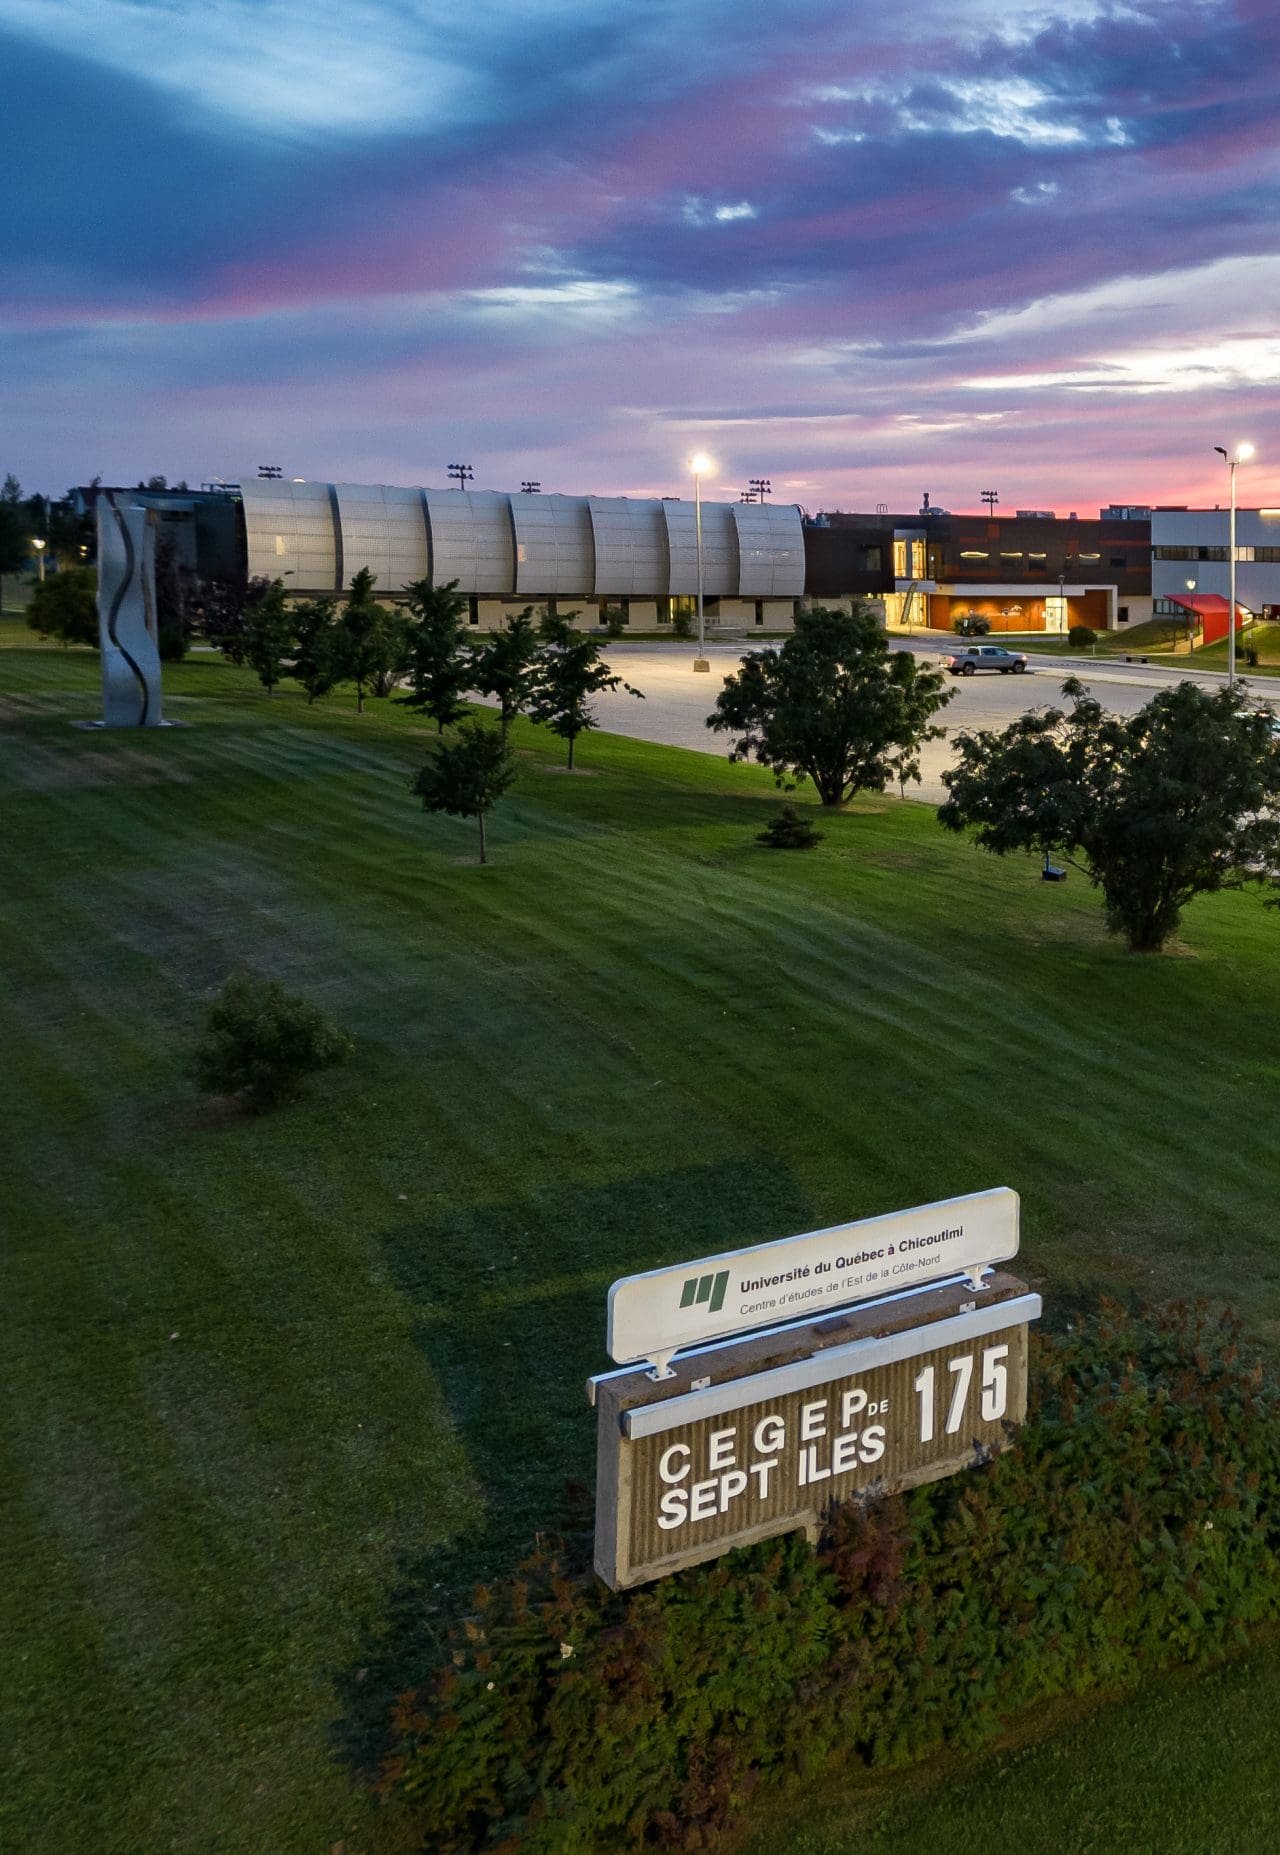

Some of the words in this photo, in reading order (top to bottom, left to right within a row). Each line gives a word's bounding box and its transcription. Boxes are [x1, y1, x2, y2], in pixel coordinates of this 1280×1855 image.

[740, 1264, 810, 1293] Université
[814, 1260, 831, 1275] du
[835, 1248, 884, 1270] Québec
[887, 1243, 895, 1256] à
[898, 1225, 964, 1252] Chicoutimi
[740, 1298, 776, 1315] Centre
[779, 1286, 823, 1306] d'études
[826, 1282, 839, 1293] de
[841, 1276, 863, 1289] l'Est
[866, 1271, 878, 1282] de
[881, 1267, 890, 1279] la
[892, 1254, 941, 1276] Côte-Nord
[659, 1389, 868, 1484] CEGEP
[868, 1399, 889, 1417] DE
[915, 1344, 1009, 1443] 175
[657, 1458, 778, 1530] SEPT
[798, 1424, 886, 1486] ILES
